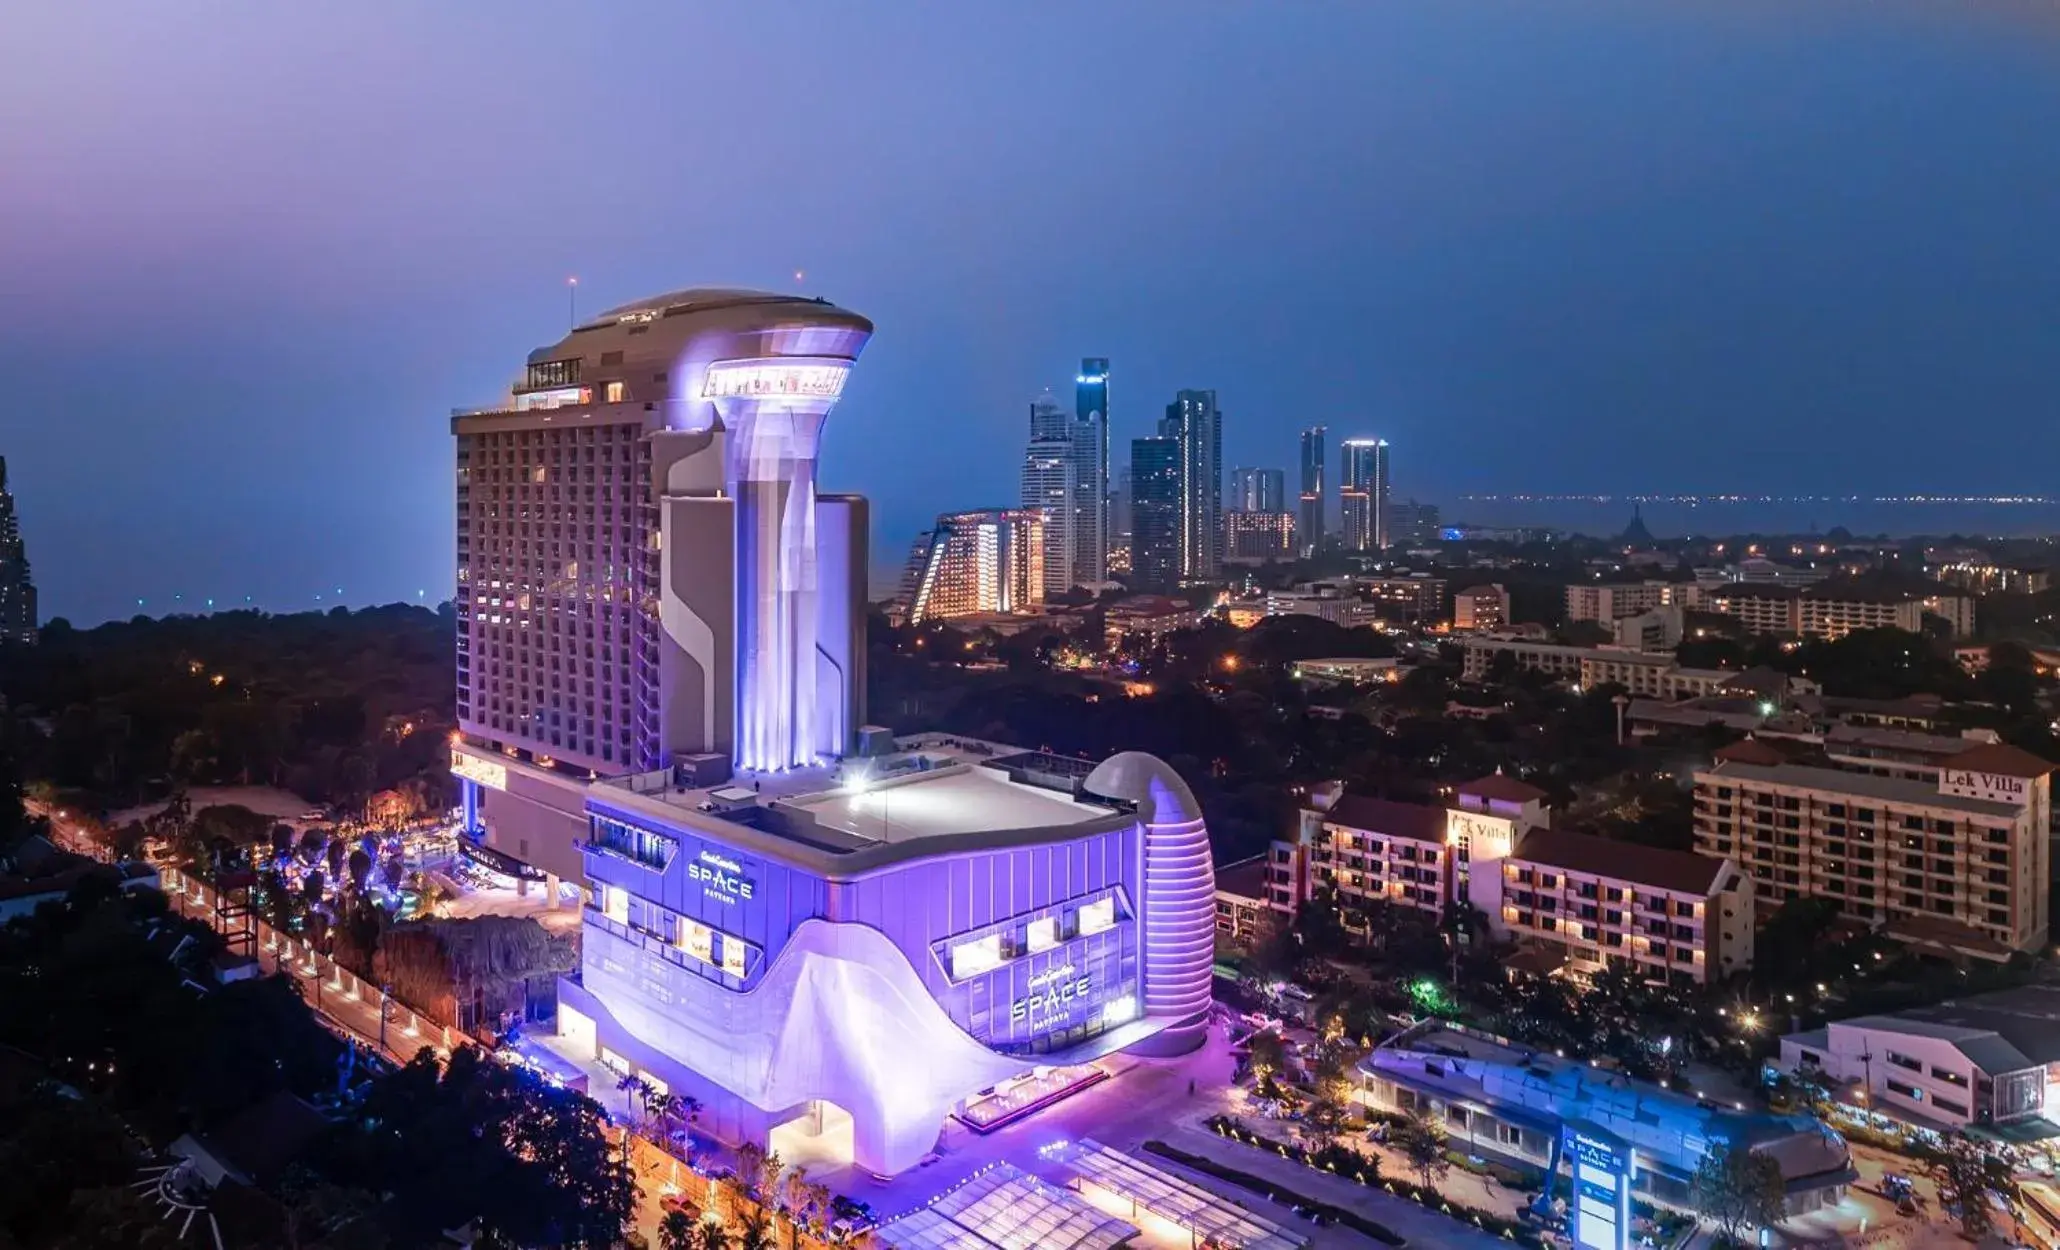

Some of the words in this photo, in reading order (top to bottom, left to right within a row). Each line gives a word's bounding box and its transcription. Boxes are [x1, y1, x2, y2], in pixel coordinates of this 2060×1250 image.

[1944, 768, 1976, 787] Lek
[1980, 774, 2022, 793] Villa
[688, 863, 752, 900] SPACE
[1012, 977, 1089, 1021] SPACE
